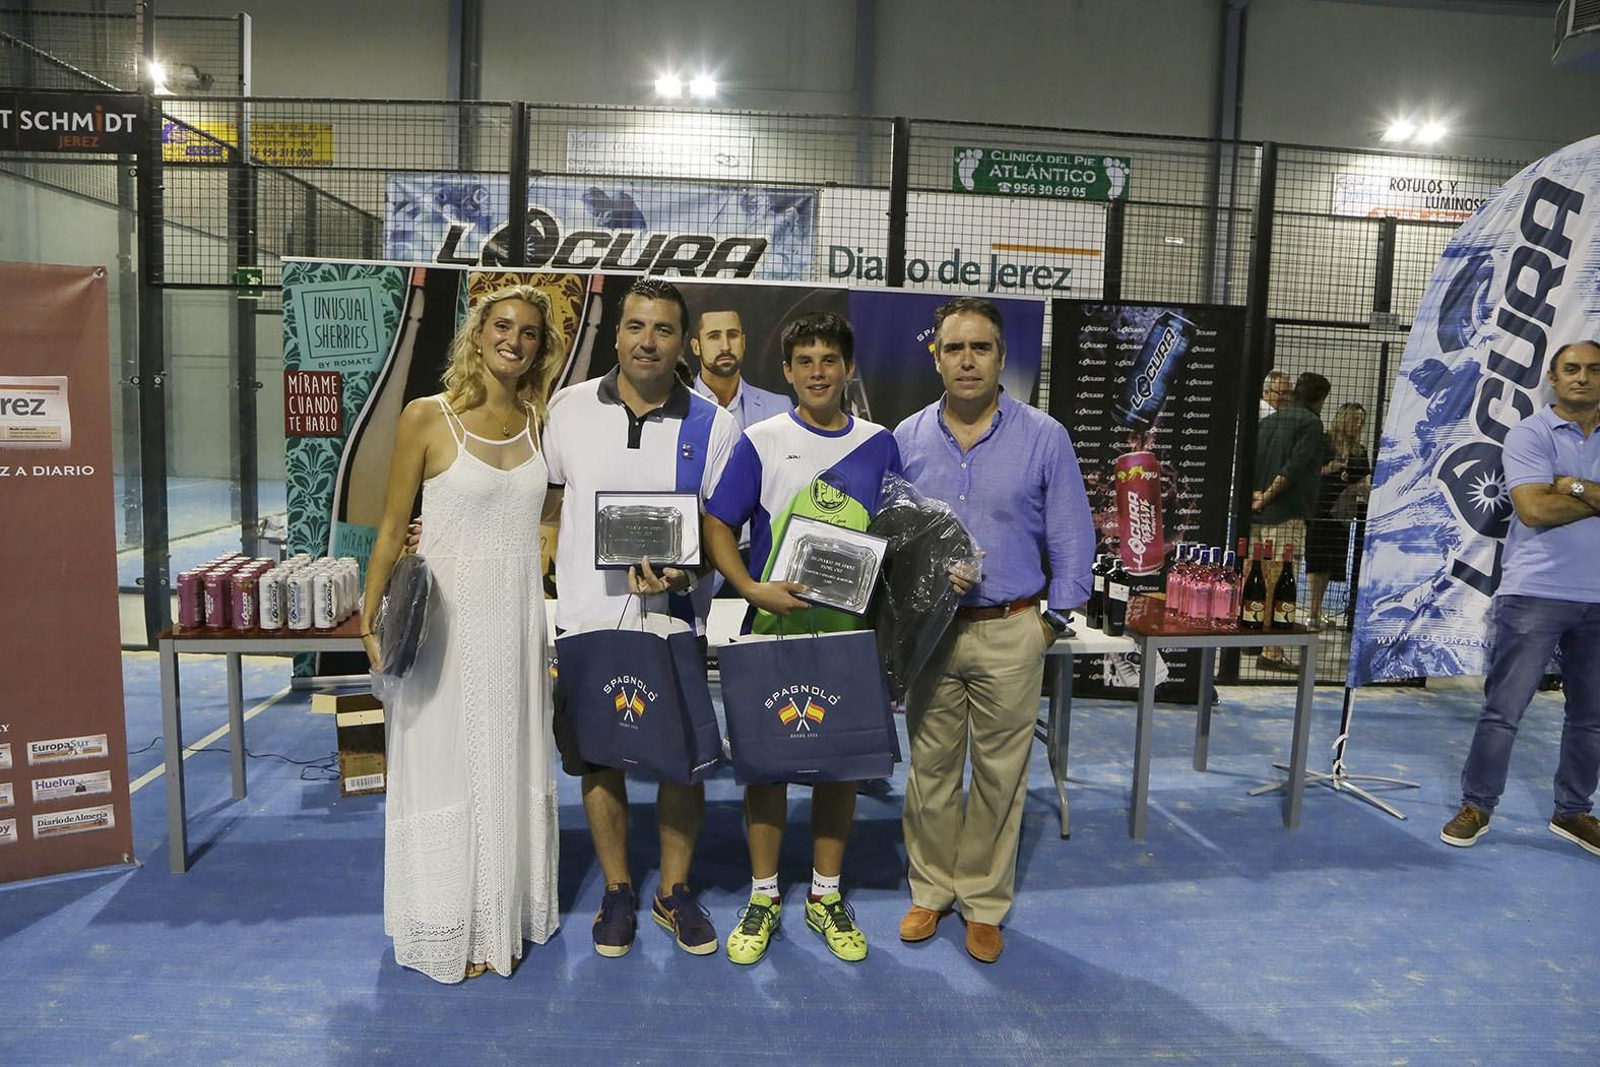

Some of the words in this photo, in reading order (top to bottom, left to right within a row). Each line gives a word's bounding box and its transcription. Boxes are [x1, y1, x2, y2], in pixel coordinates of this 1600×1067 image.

[59, 135, 100, 148] JEREZ
[989, 164, 1097, 184] ATLÁNTICO
[1013, 183, 1037, 195] 956
[1038, 185, 1053, 195] 30
[1054, 186, 1071, 196] 69
[1072, 187, 1087, 198] 05
[1449, 180, 1459, 195] Y
[436, 207, 769, 279] LOCURA
[828, 243, 930, 284] Diao
[937, 247, 981, 287] de
[986, 252, 1072, 294] Jerez
[313, 297, 369, 322] UNUSUAL
[313, 324, 369, 349] SHERRIES
[318, 361, 331, 369] BY
[333, 357, 373, 368] ROMATE
[288, 372, 338, 395] MÍRAME
[288, 396, 338, 415] CUANDO
[288, 416, 301, 432] TE
[305, 416, 337, 432] HABLO
[15, 466, 28, 476] A
[33, 465, 95, 476] DIARIO
[603, 675, 656, 702] SPAGNOLO
[764, 684, 838, 709] SPAGNOLO
[36, 778, 75, 790] Huelva
